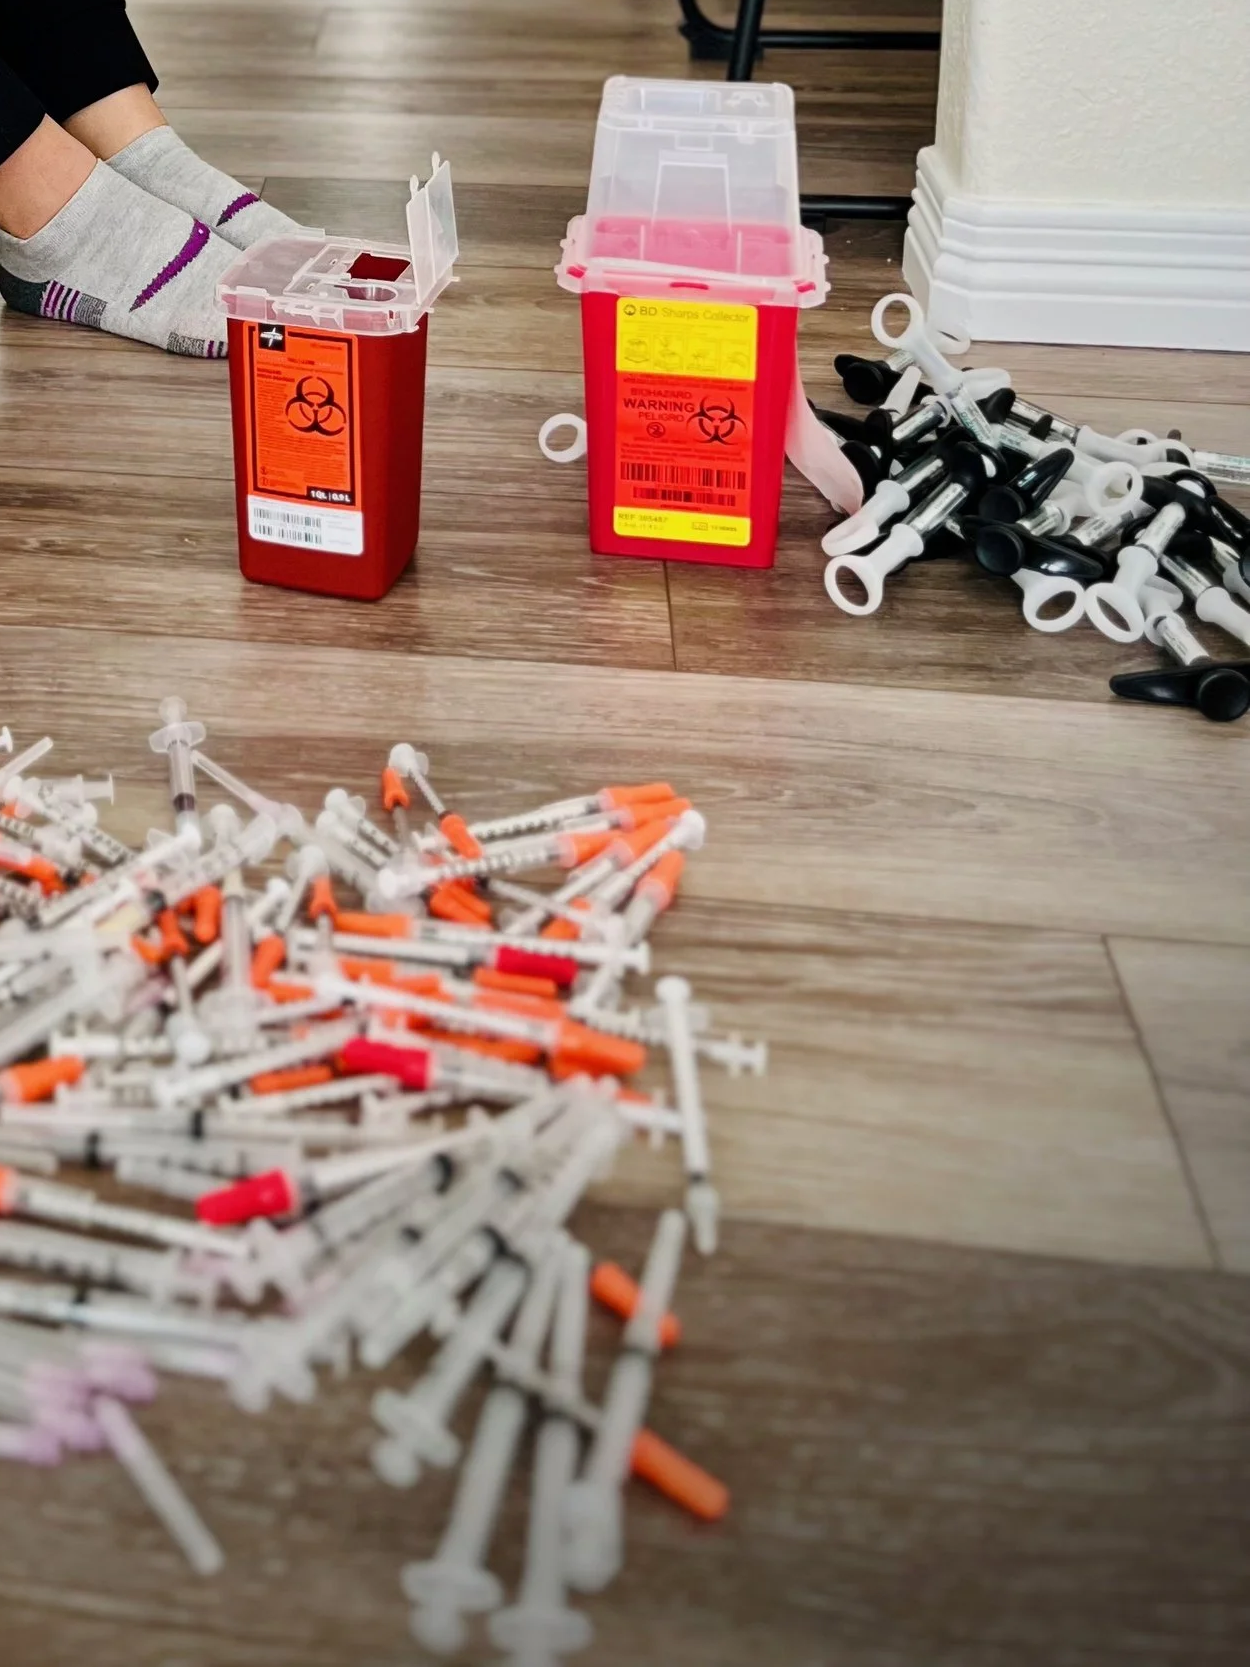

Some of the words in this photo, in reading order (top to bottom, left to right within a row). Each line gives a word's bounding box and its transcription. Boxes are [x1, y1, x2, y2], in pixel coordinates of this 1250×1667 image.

[639, 306, 658, 316] BD
[662, 307, 699, 320] Sharps
[702, 309, 750, 322] Collector
[630, 387, 692, 399] BIOHAZARD
[623, 397, 695, 413] WARNING
[638, 411, 685, 423] PELIGRO
